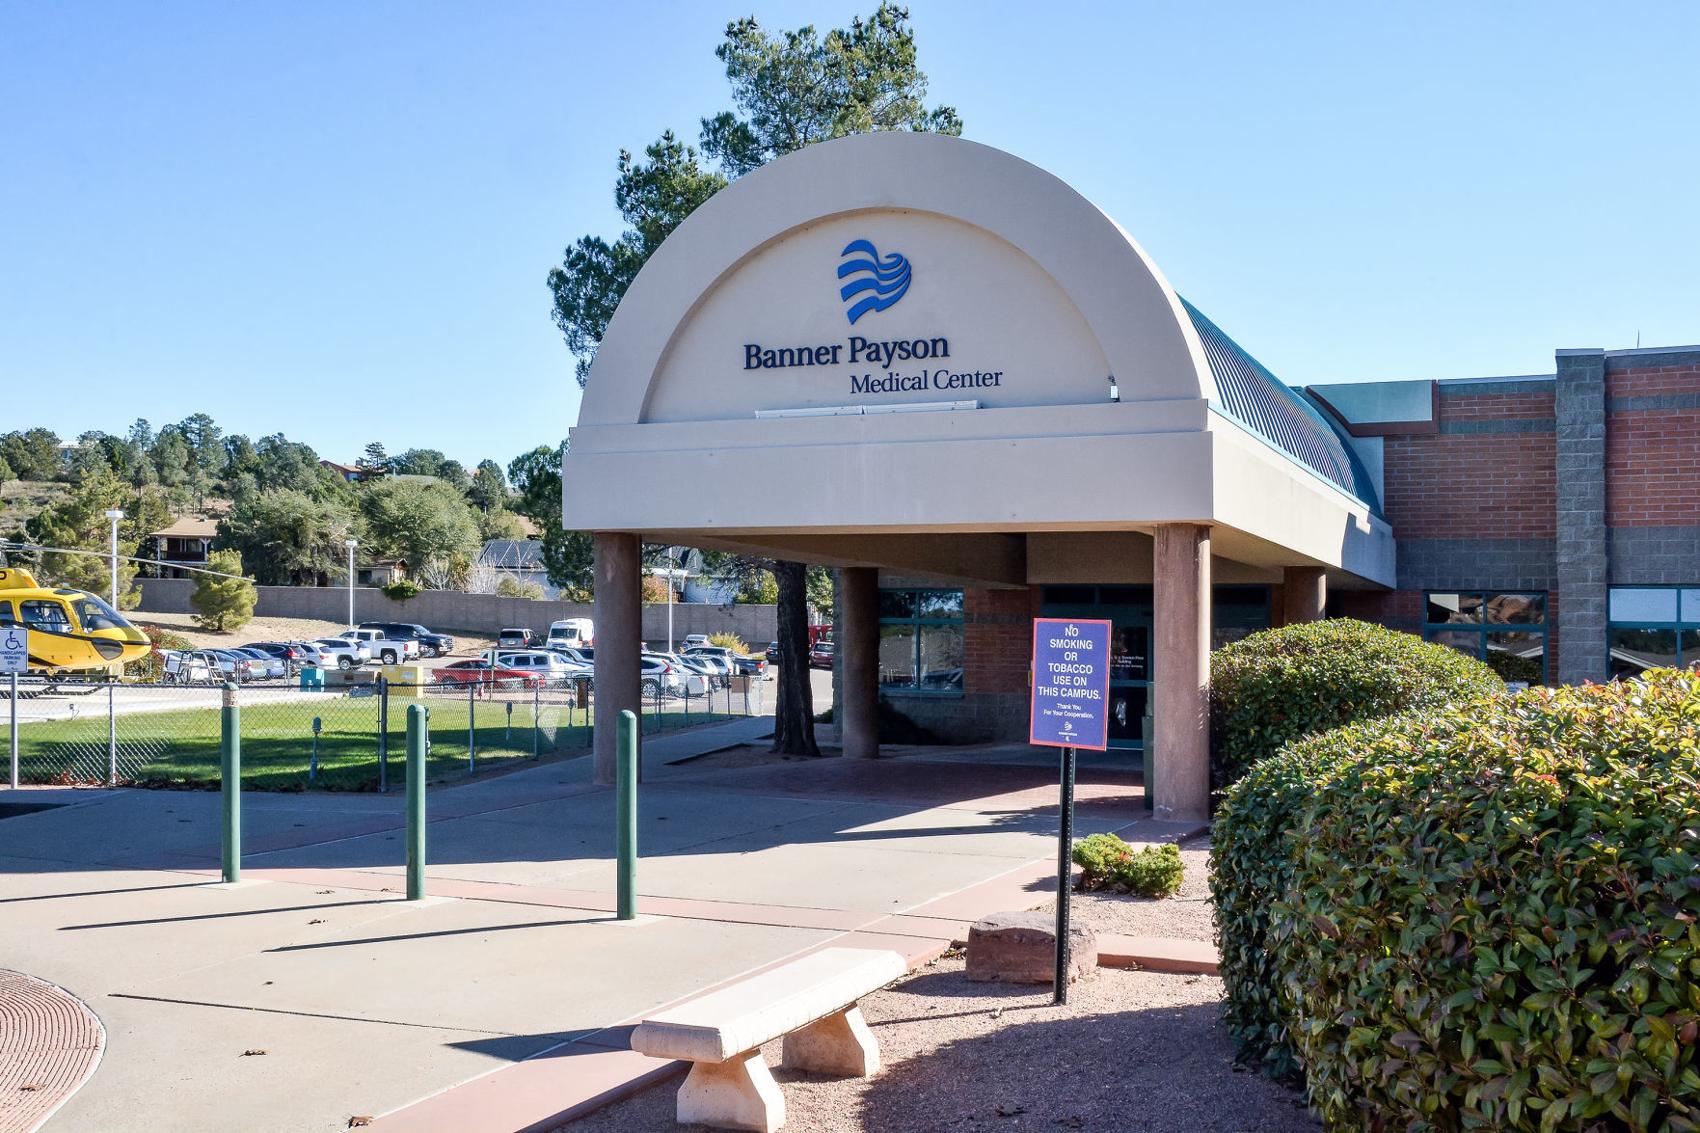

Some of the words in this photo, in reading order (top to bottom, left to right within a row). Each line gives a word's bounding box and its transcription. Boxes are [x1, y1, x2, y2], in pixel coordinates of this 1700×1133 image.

[743, 344, 843, 370] Banner
[848, 337, 950, 369] Payson
[850, 370, 929, 394] Medical
[933, 370, 1003, 390] Center
[1065, 627, 1079, 637] NO
[1050, 639, 1093, 650] SMOKING
[1064, 652, 1078, 661] OR
[1048, 663, 1093, 674] TOBACCO
[1053, 675, 1071, 685] USE
[1073, 676, 1087, 686] ON
[1038, 686, 1058, 696] THIS
[1060, 688, 1101, 700] CAMPUS.
